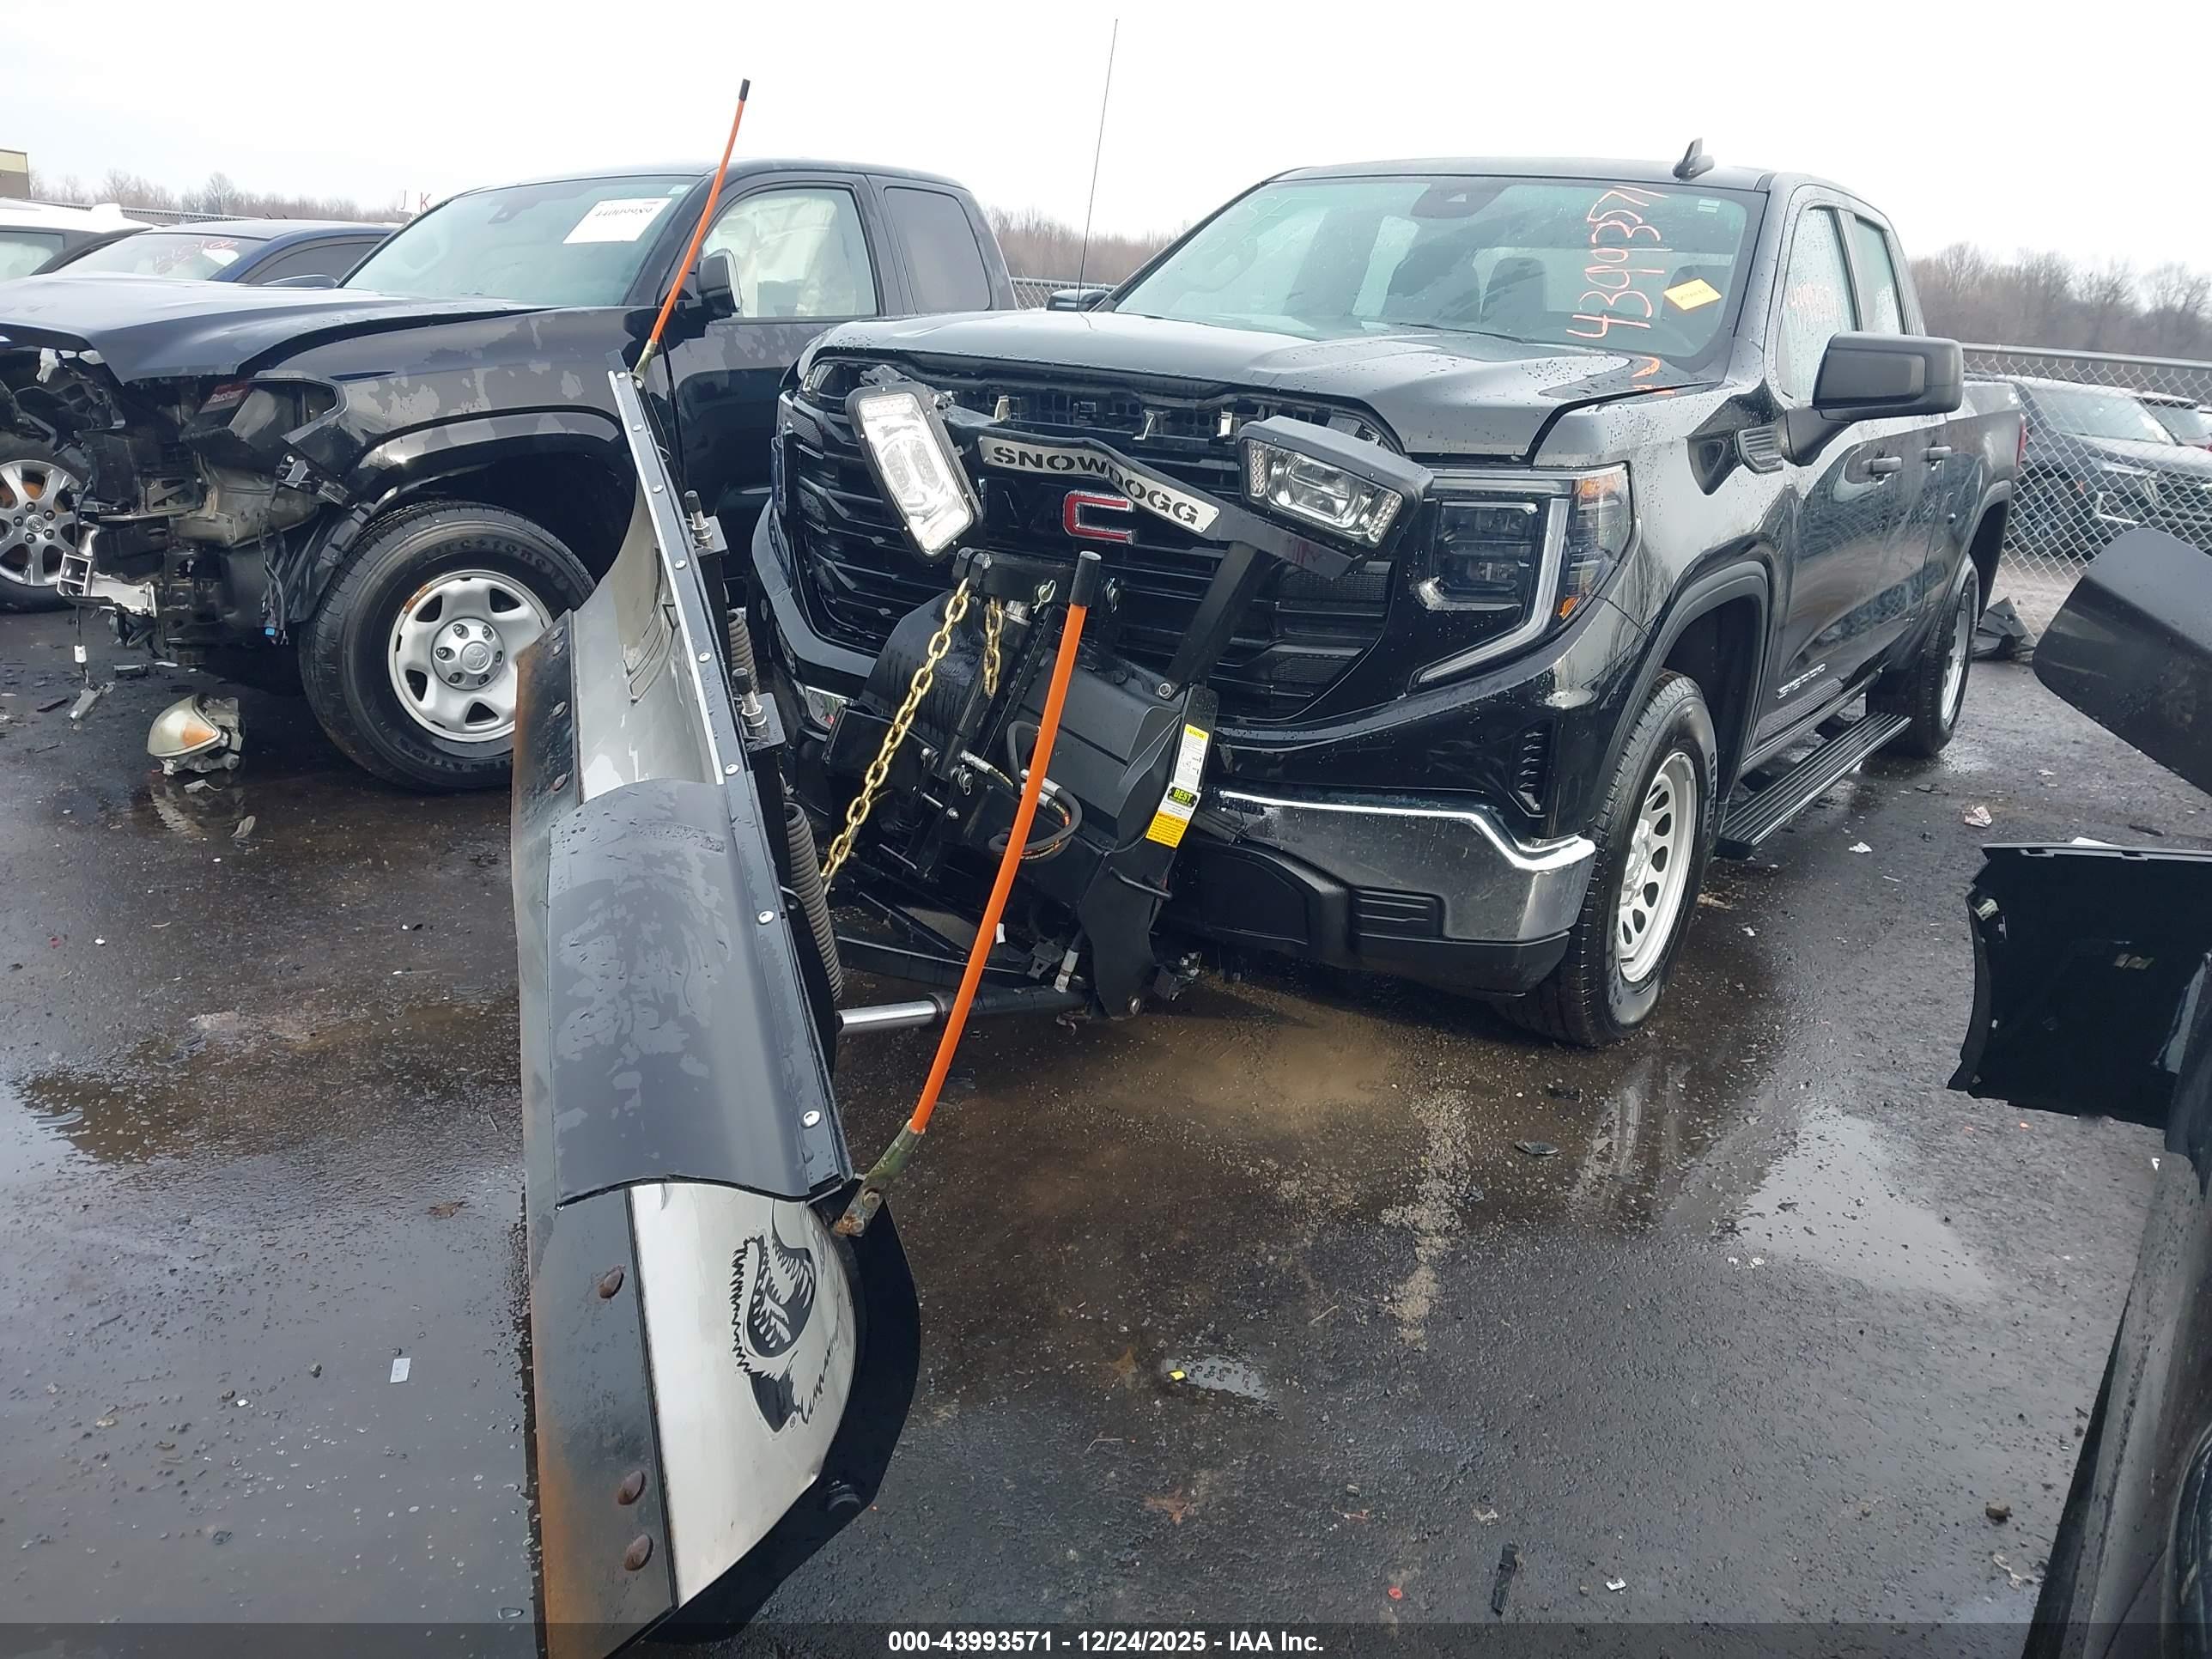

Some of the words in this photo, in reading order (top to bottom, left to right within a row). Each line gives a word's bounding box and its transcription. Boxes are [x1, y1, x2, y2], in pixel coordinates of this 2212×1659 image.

[993, 446, 1200, 526] SNOWDOGG
[1775, 662, 1827, 700] SIERRA
[1173, 788, 1194, 803] BEST
